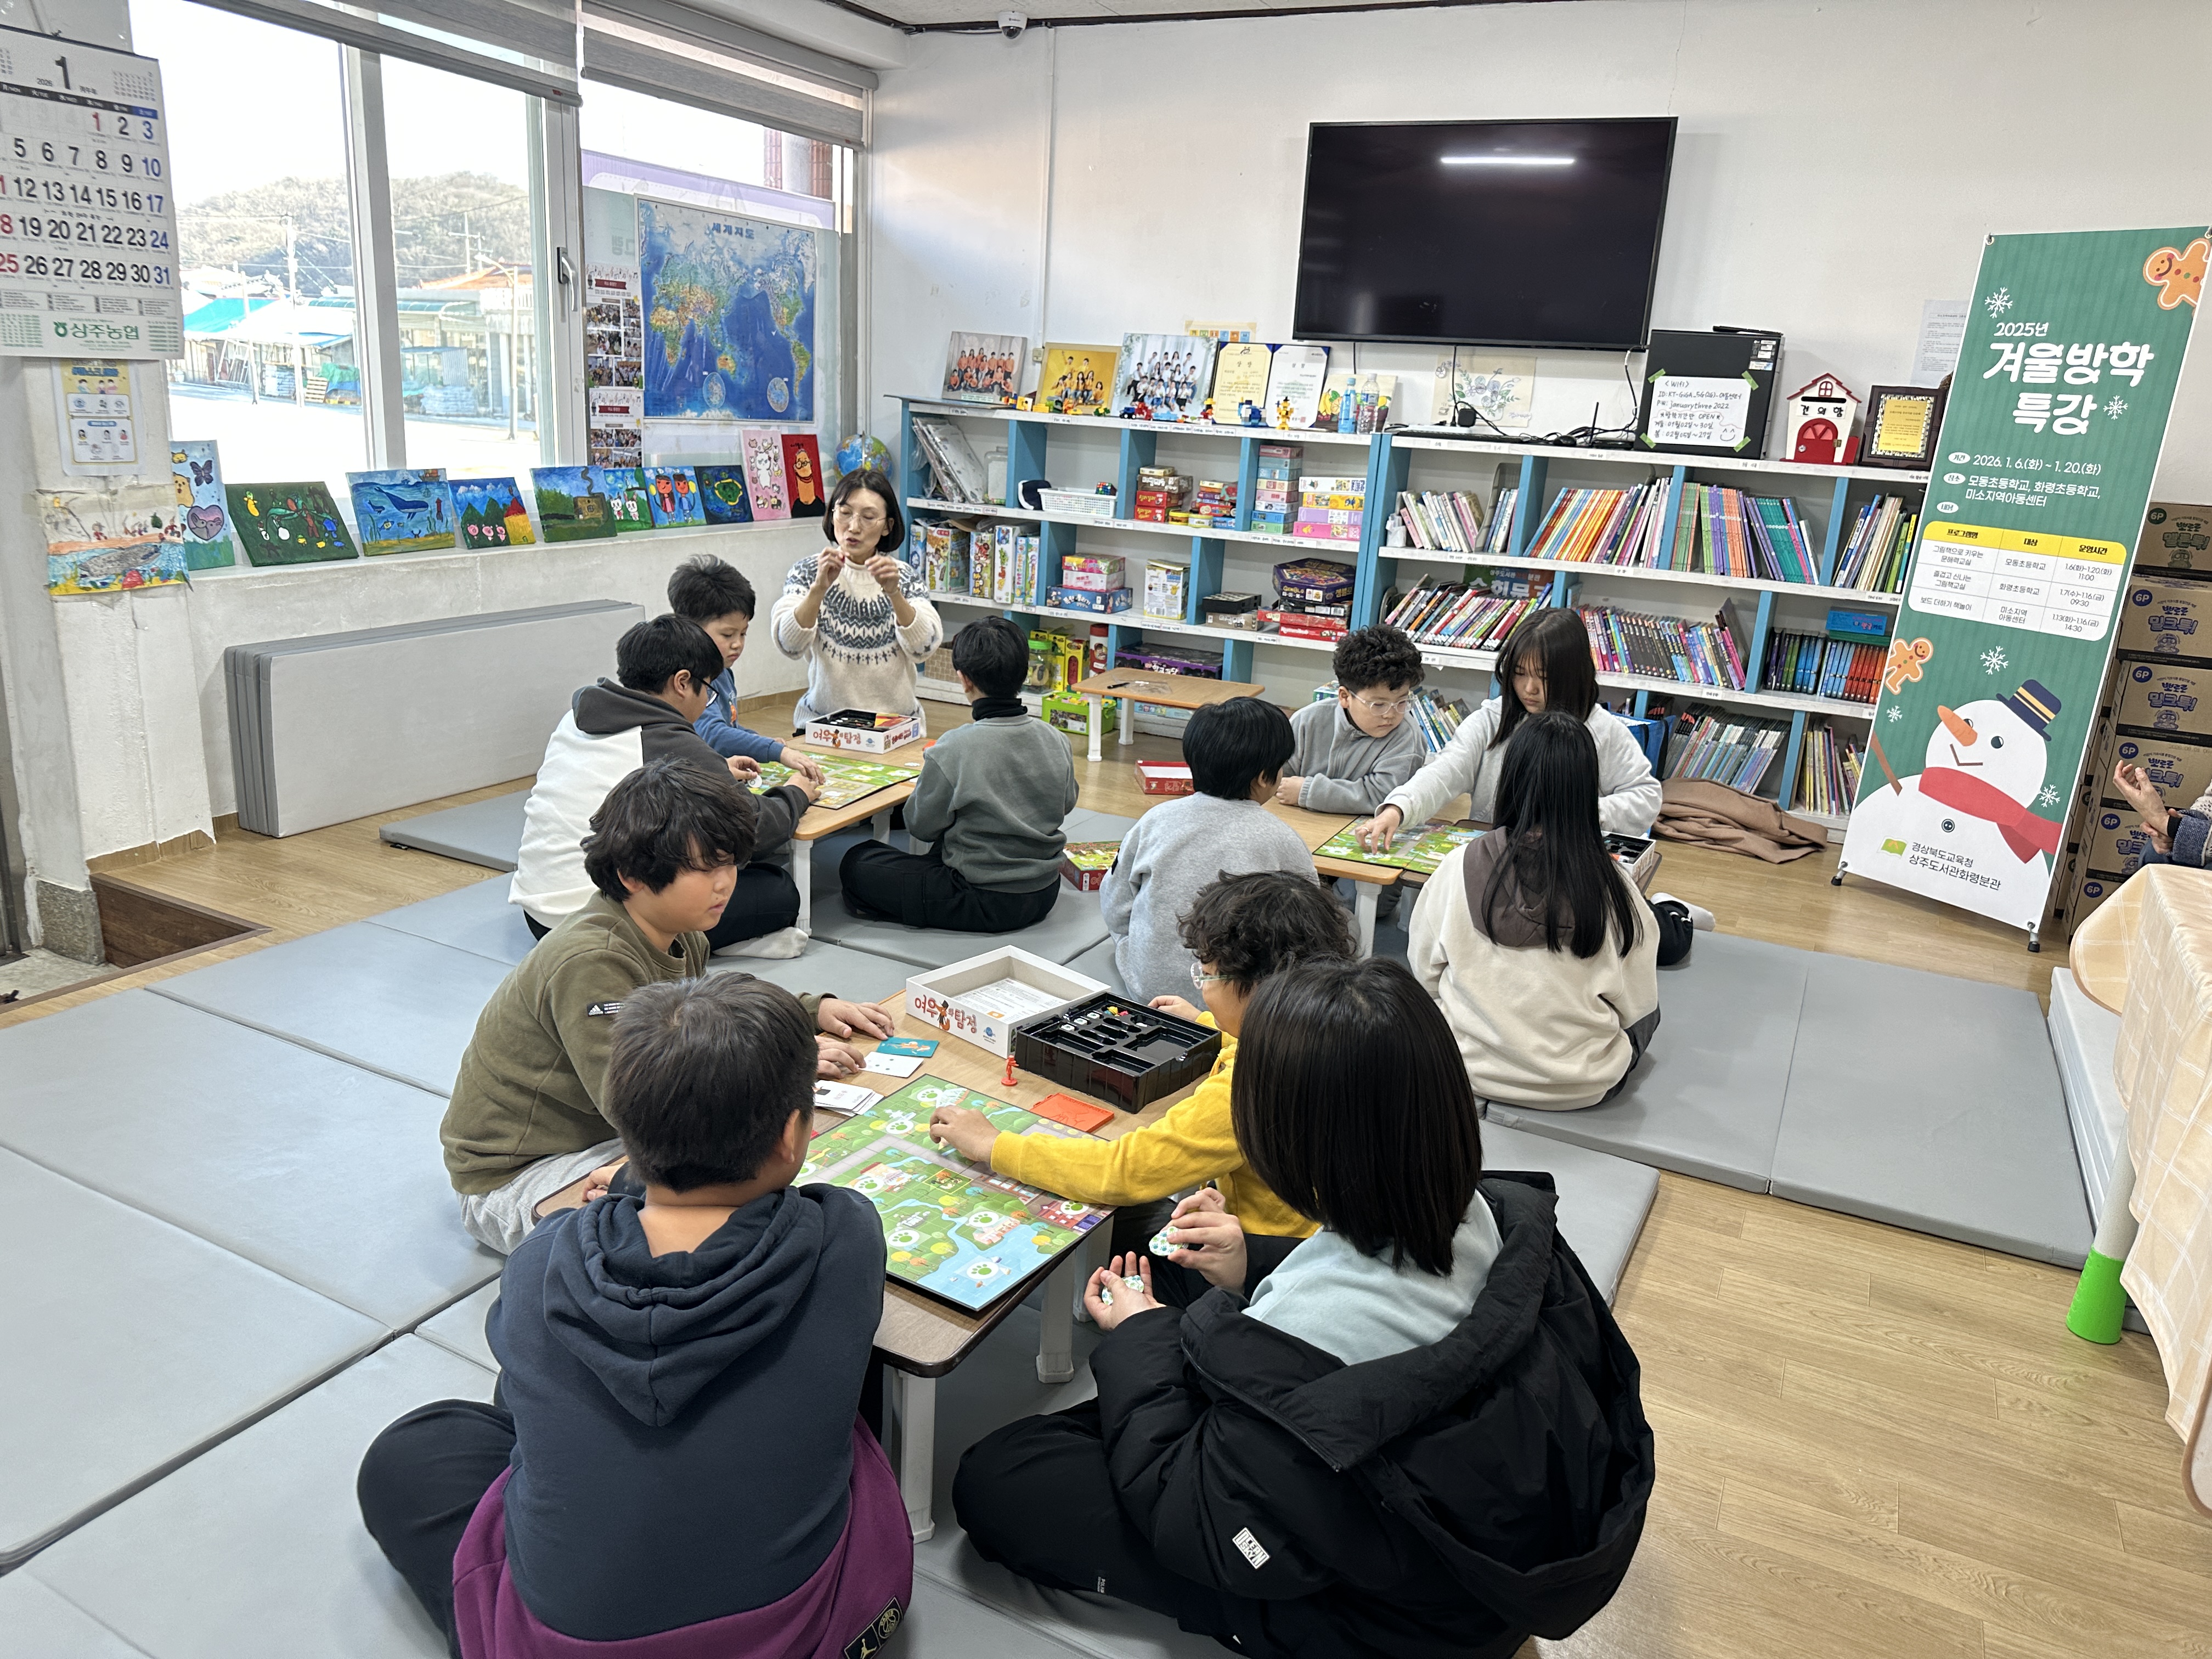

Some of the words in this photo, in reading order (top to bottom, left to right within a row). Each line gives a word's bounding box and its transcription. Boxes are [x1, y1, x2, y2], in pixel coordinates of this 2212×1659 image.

[55, 56, 70, 89] 1
[37, 77, 53, 87] 2026
[92, 111, 101, 132] 1
[117, 116, 129, 136] 2
[142, 121, 154, 140] 3
[14, 138, 26, 157] 5
[42, 142, 54, 162] 6
[68, 145, 79, 165] 7
[95, 150, 108, 170] 8
[121, 154, 133, 173] 9
[142, 156, 161, 177] 10
[14, 177, 37, 198] 12
[42, 180, 65, 201] 13
[70, 184, 92, 205] 14
[96, 187, 117, 207] 15
[122, 190, 142, 210] 16
[146, 194, 163, 213] 17
[19, 216, 42, 236] 19
[47, 219, 70, 239] 20
[76, 222, 96, 242] 21
[101, 224, 122, 245] 22
[126, 227, 146, 247] 23
[150, 230, 169, 249] 24
[712, 222, 754, 240] 세계지도
[0, 253, 19, 273] 25
[24, 255, 48, 275] 26
[52, 257, 74, 277] 27
[80, 259, 102, 279] 28
[106, 262, 126, 281] 29
[131, 264, 150, 283] 30
[154, 266, 171, 285] 31
[70, 323, 139, 340] 상주농협
[1993, 322, 2049, 337] 2025년
[1983, 341, 2154, 387] 겨울방학
[2012, 392, 2098, 435] 특강
[1953, 454, 1966, 462] 기간
[1972, 454, 2002, 467] 2026.
[2063, 462, 2102, 476] 20.(화)
[1968, 475, 2032, 493] 모동초등학교,
[2033, 481, 2101, 500] 화령초등학교,
[1965, 488, 2047, 507] 미소지역아동센터
[2150, 512, 2164, 521] 6P
[2176, 521, 2202, 532] 뽀로로
[1946, 528, 1978, 539] 프로그램명
[2023, 538, 2038, 546] 대상
[1932, 545, 1964, 556] 그림책으로
[1965, 550, 1984, 558] 키우는
[2079, 544, 2108, 555] 운영시간
[1940, 555, 1972, 566] 문해력교실
[2005, 558, 2046, 571] 모동초등학교
[1489, 569, 1516, 579] 상주도서관
[1933, 570, 1951, 579] 즐겁고
[1953, 573, 1972, 583] 신나는
[2078, 572, 2095, 582] 11:00
[1934, 579, 1966, 590] 그림책교실
[1999, 583, 2040, 595] 화령초등학교
[1920, 596, 1933, 605] 보드
[1933, 597, 1953, 607] 더하기
[1953, 600, 1972, 611] 책놀이
[2070, 599, 2090, 607] 09:30
[2135, 594, 2150, 602] 6P
[2000, 606, 2028, 617] 미소지역
[2162, 605, 2189, 616] 뽀로로
[1998, 613, 2026, 624] 아동센터
[2064, 623, 2083, 633] 14:30
[2135, 670, 2150, 679] 6P
[2162, 682, 2188, 693] 뽀로로
[844, 732, 861, 744] 탐정
[2121, 746, 2136, 755] 6P
[2148, 758, 2175, 769] 뽀로로
[2104, 817, 2118, 826] 6P
[1911, 842, 1974, 868] 경상북도교육청
[1909, 854, 2002, 891] 상주도서관화령분관
[2086, 886, 2101, 895] 6P
[955, 1008, 978, 1034] 탐정
